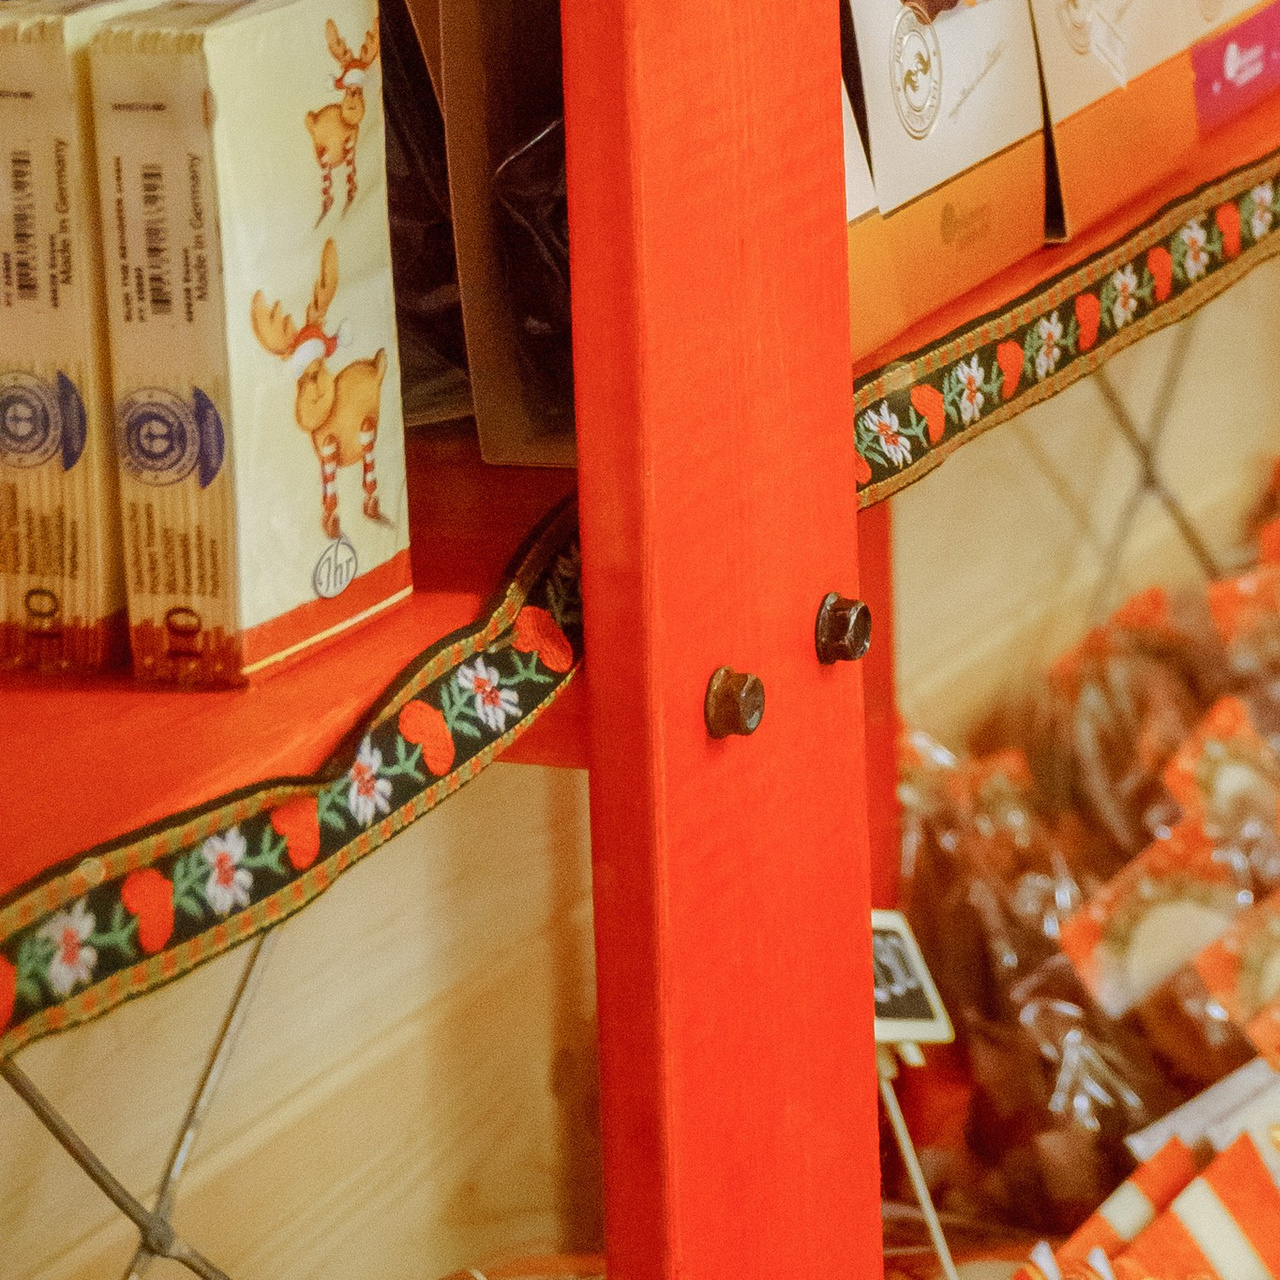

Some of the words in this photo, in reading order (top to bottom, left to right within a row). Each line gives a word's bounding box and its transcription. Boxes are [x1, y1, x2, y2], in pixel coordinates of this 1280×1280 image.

[54, 138, 70, 214] Germany
[187, 151, 204, 231] Germany
[58, 217, 69, 234] in
[194, 232, 205, 251] in
[59, 238, 72, 285] Made
[196, 254, 209, 302] Made
[24, 588, 62, 638] 10
[164, 606, 202, 658] 10
